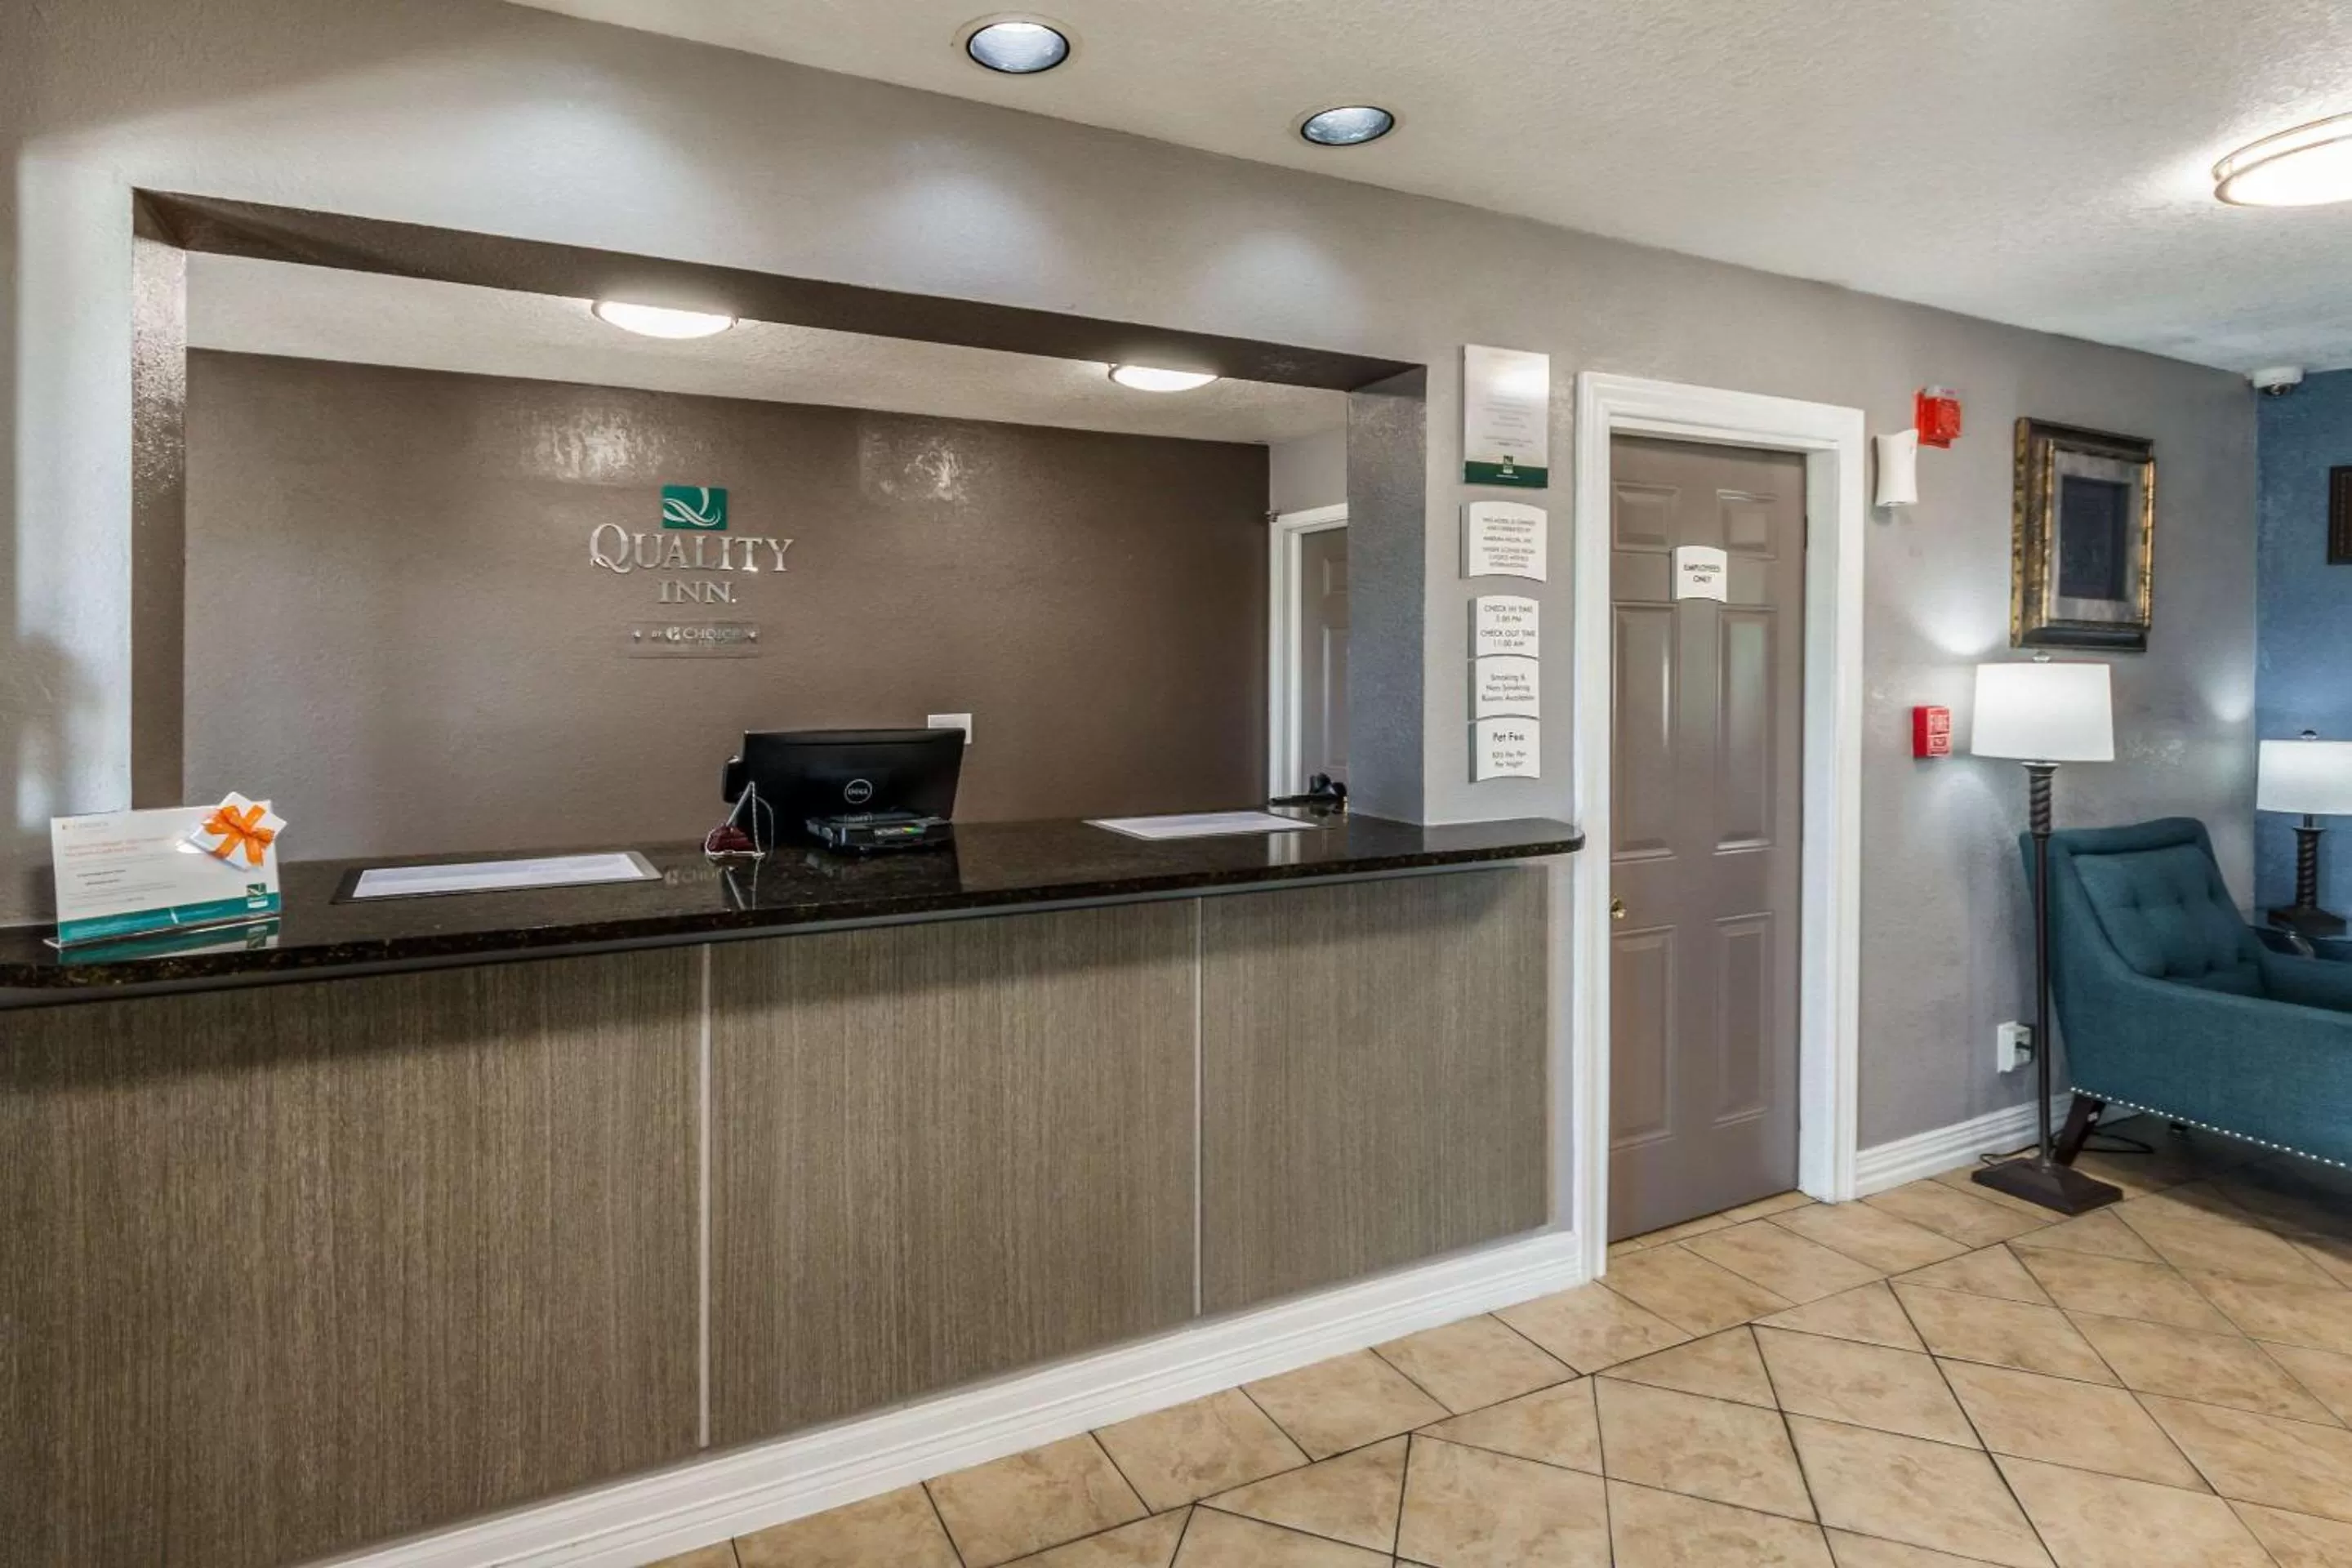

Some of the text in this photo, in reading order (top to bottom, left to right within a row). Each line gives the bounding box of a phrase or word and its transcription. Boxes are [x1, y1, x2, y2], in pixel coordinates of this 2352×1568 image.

[590, 523, 795, 574] QUALITY
[1483, 604, 1506, 612] CHECK
[1492, 732, 1524, 742] Pet Fee
